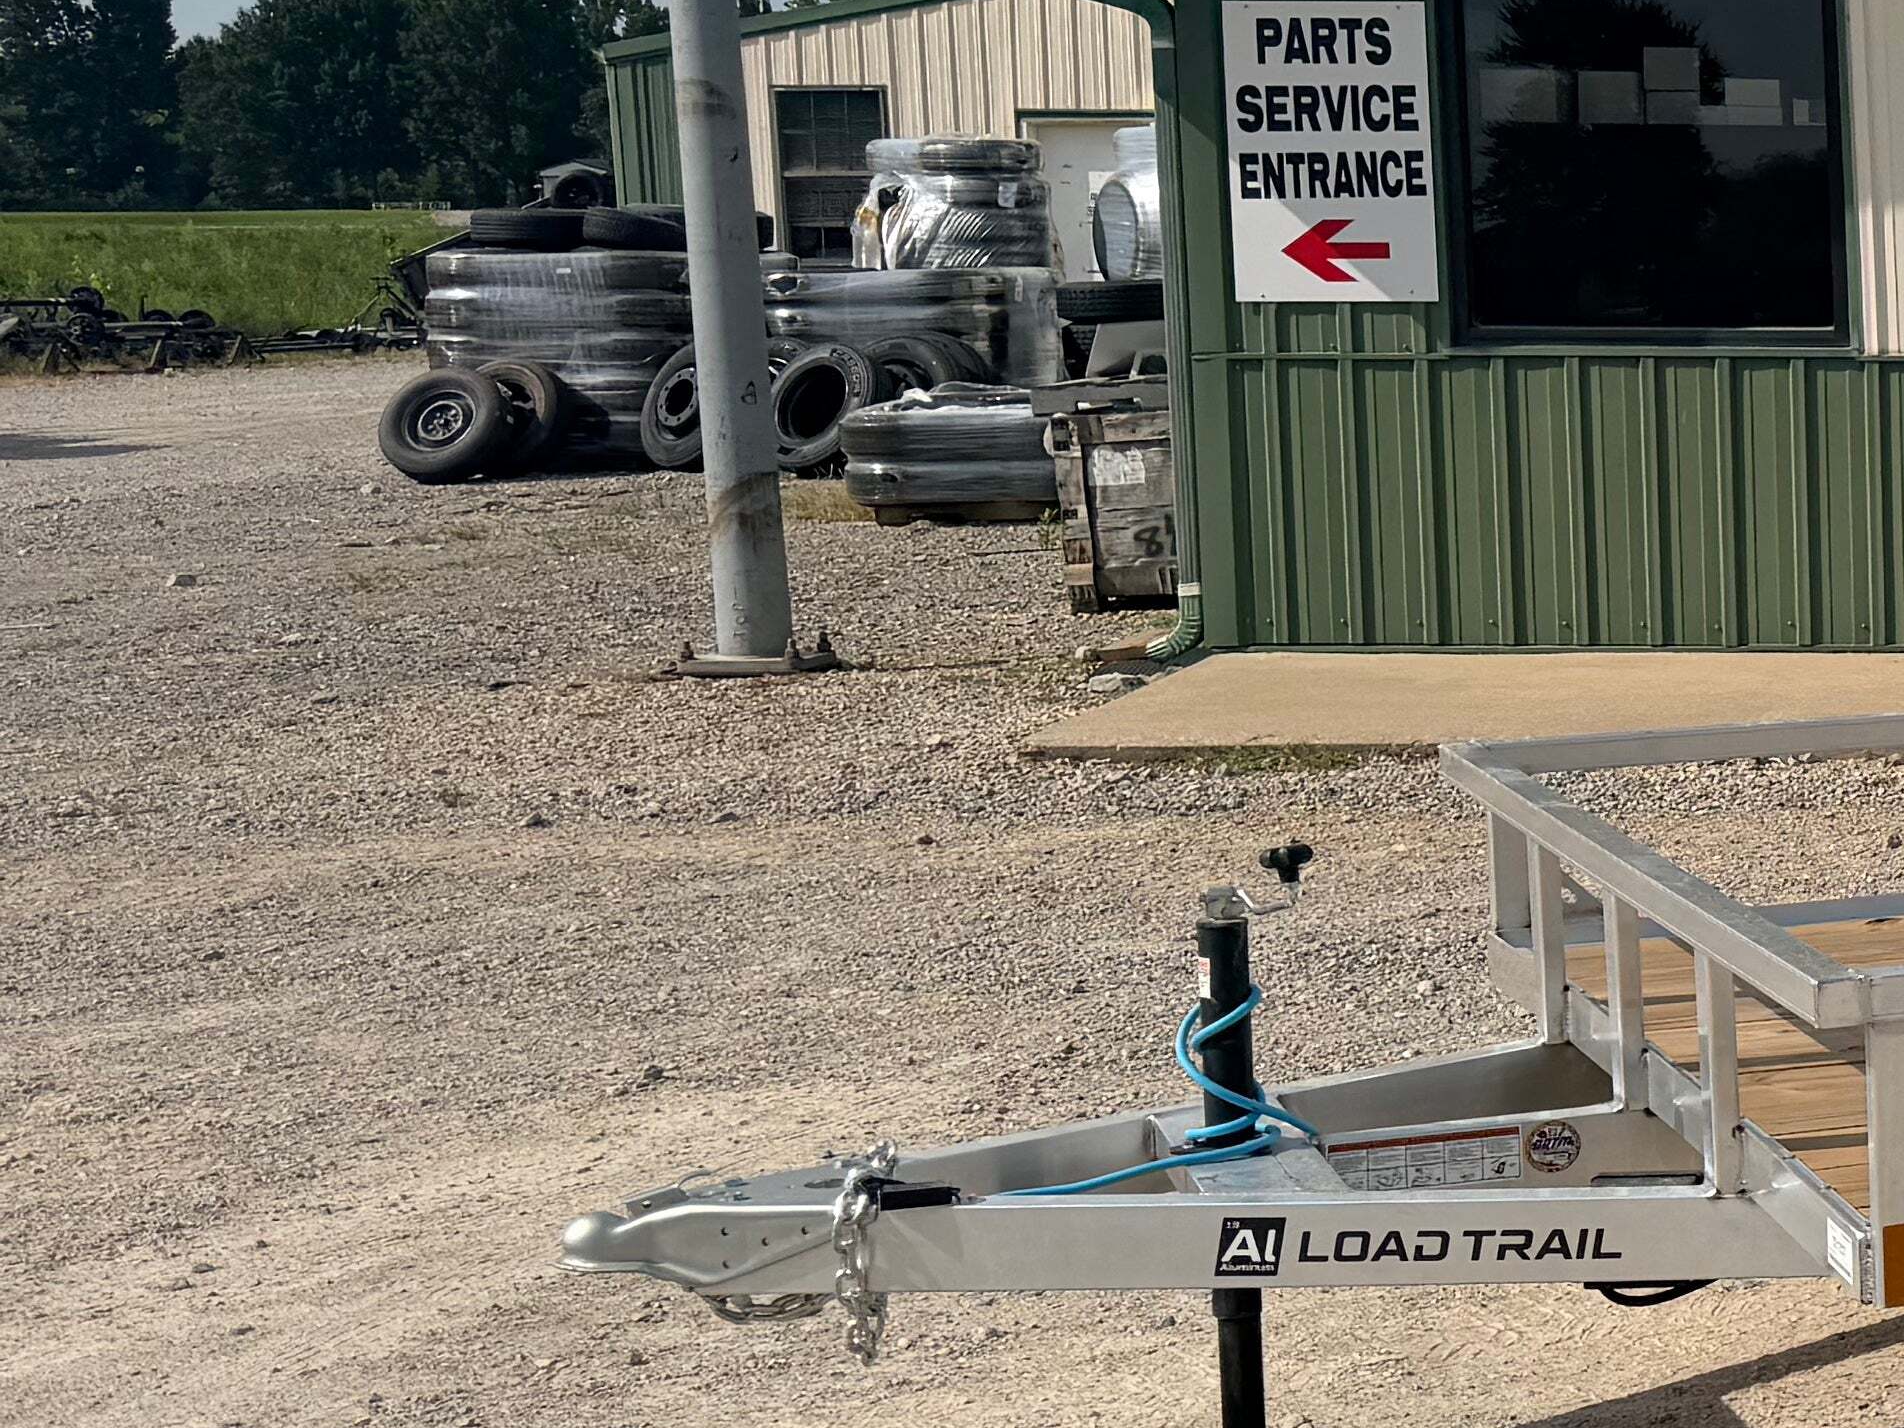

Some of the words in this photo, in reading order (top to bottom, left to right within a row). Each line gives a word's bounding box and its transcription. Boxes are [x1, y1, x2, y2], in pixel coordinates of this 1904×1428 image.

[1255, 17, 1391, 65] PARTS
[1236, 84, 1419, 133] SERVICE
[1238, 150, 1428, 200] ENTRANCE
[1221, 1228, 1276, 1263] Al
[1298, 1230, 1451, 1264] LOAD
[1463, 1228, 1623, 1261] TRAIL
